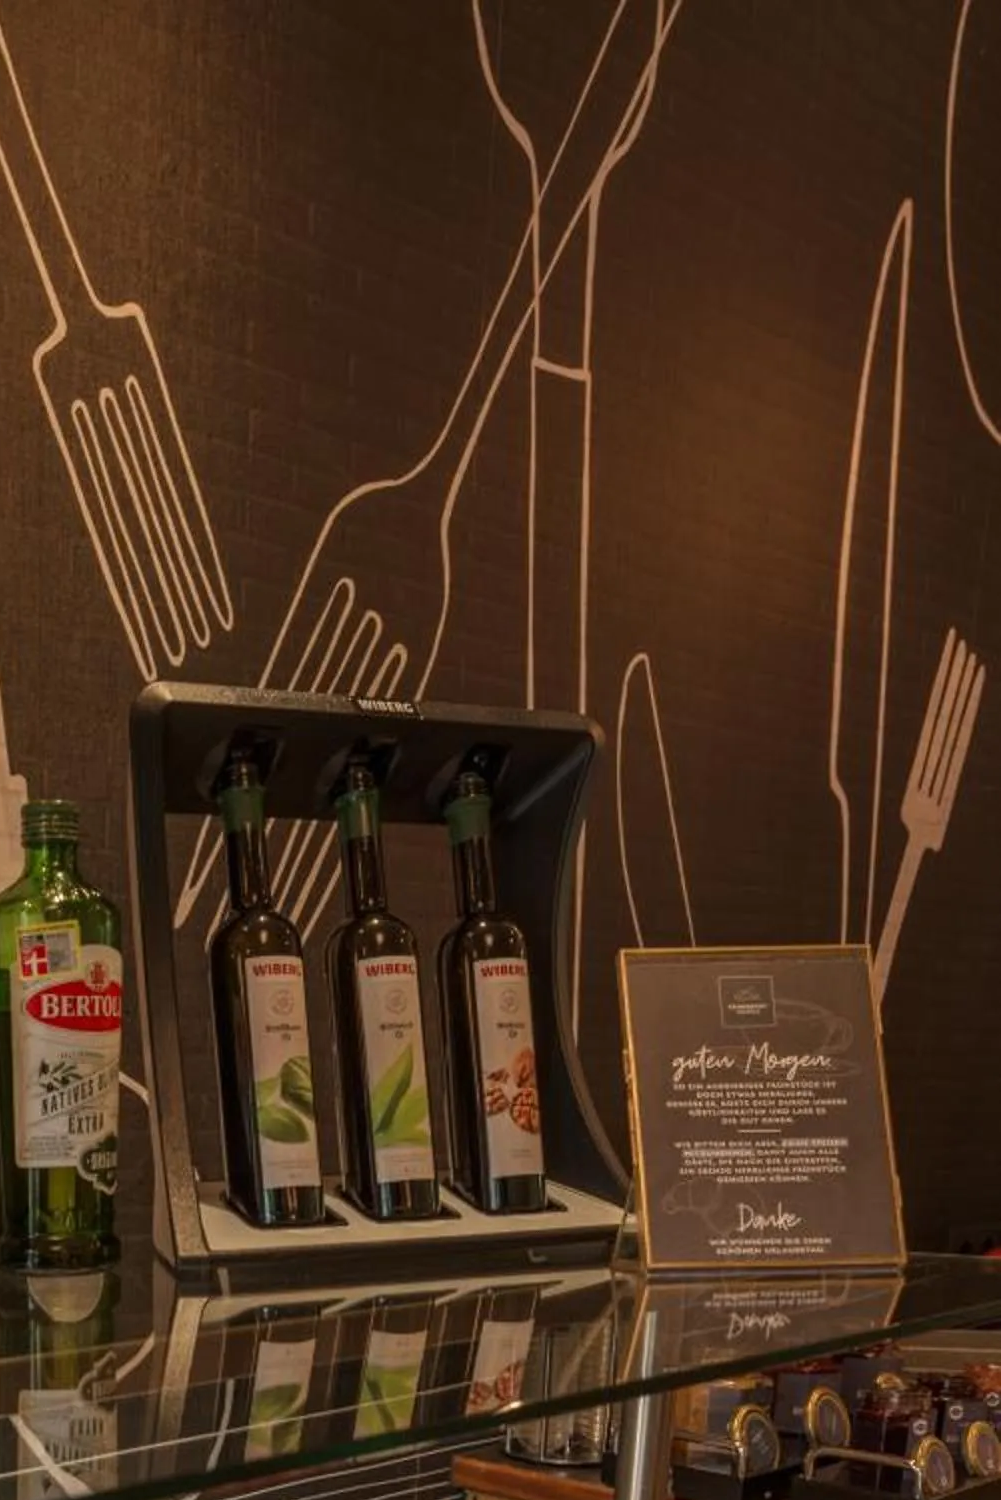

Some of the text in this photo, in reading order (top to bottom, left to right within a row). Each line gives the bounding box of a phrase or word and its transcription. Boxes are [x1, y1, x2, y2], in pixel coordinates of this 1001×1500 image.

[358, 699, 414, 713] WIBERG
[672, 1045, 735, 1082] guten
[736, 1201, 802, 1232] Danke
